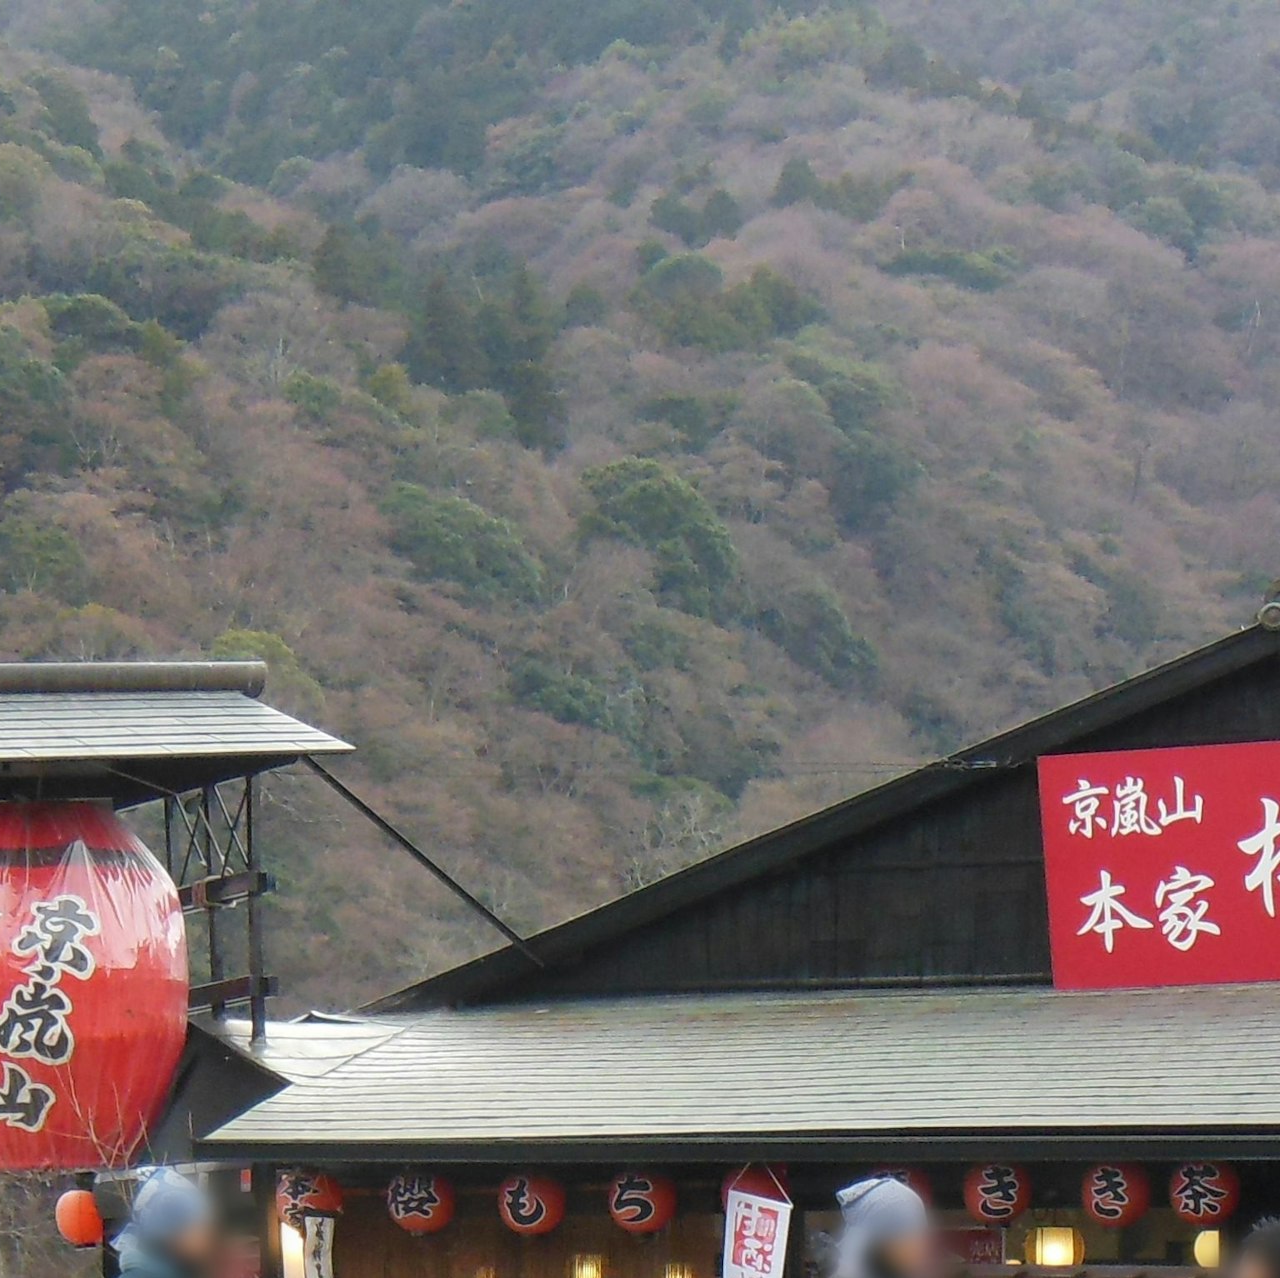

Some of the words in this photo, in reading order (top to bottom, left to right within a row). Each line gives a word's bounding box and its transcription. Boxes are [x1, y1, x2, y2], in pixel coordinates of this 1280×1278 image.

[1062, 776, 1204, 839] 京嵐山
[1077, 866, 1221, 954] 本家
[504, 1178, 547, 1227] も
[613, 1176, 656, 1224] ち
[977, 1165, 1020, 1219] き
[1091, 1166, 1129, 1218] き
[1173, 1165, 1229, 1217] 茶
